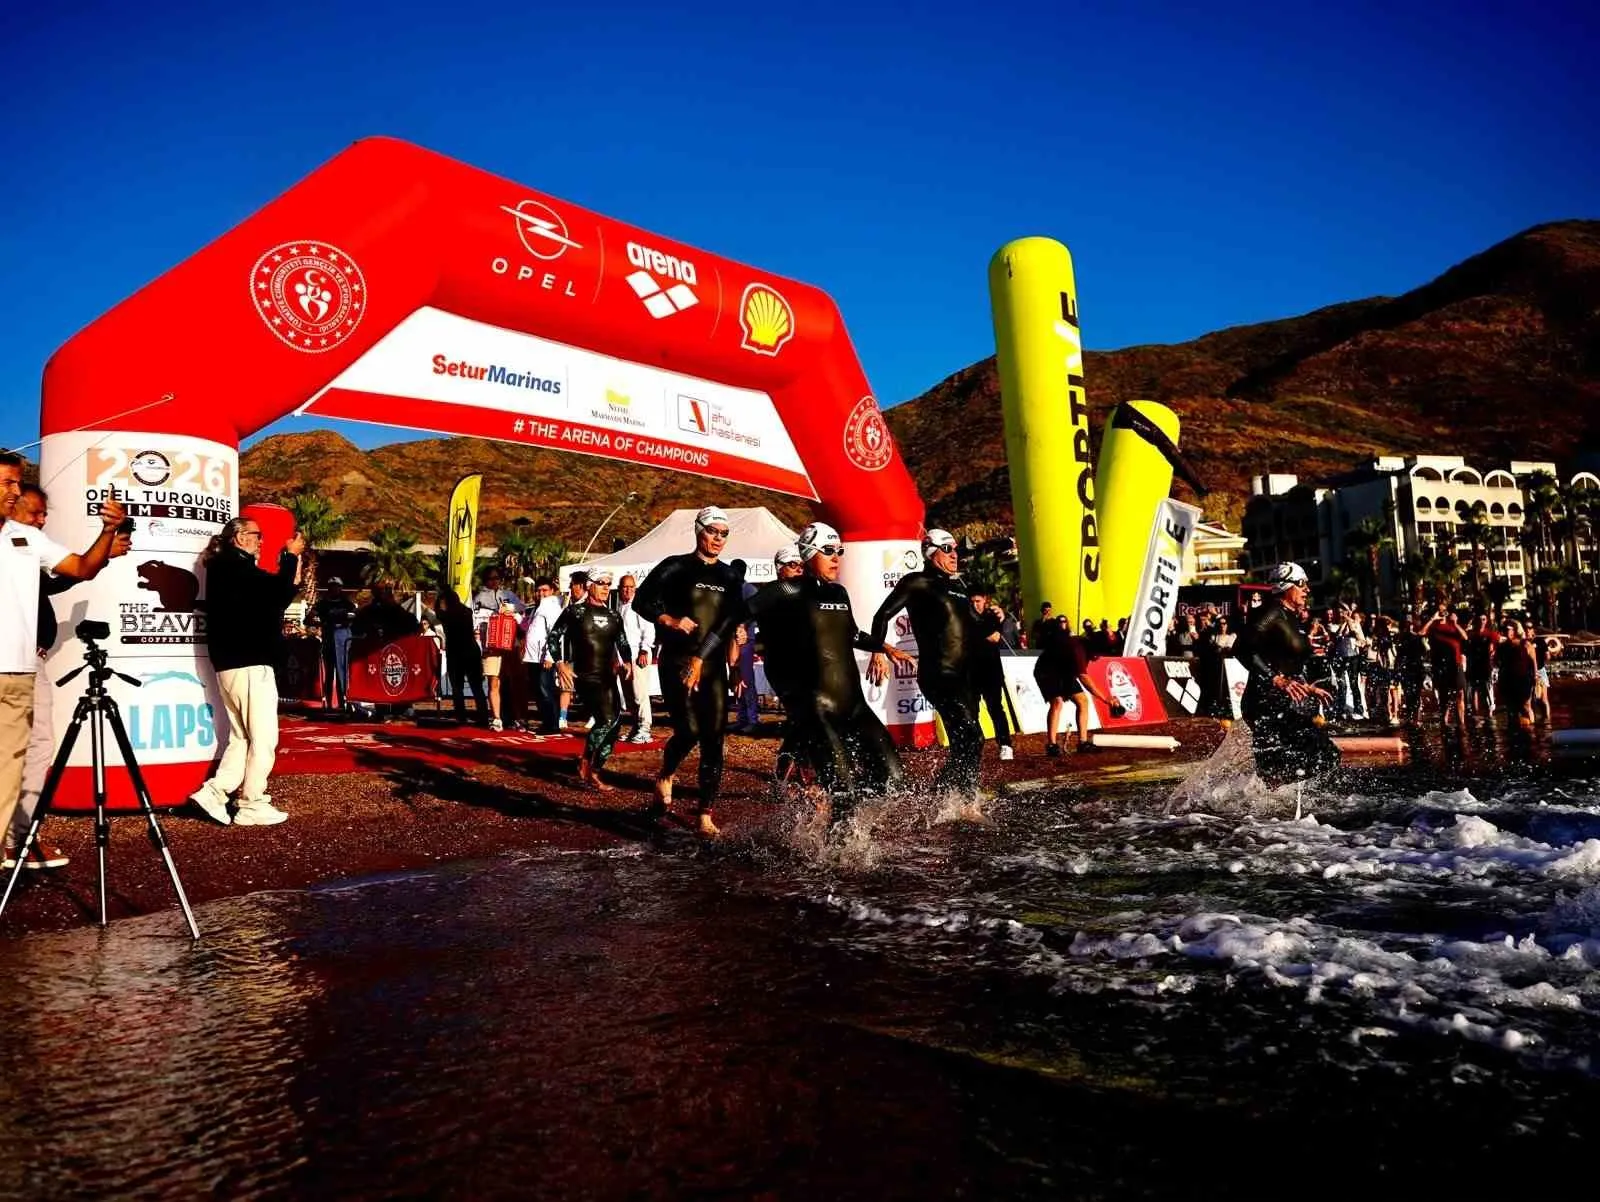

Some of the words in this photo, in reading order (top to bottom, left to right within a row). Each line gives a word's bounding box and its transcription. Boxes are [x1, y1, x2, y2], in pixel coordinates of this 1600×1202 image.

[491, 257, 577, 297] OPEL
[626, 242, 697, 284] arena
[431, 353, 561, 395] SeturMarinas
[529, 420, 557, 439] THE
[560, 427, 611, 449] ARENA
[613, 436, 633, 452] OF
[635, 440, 710, 467] CHAMPIONS
[1054, 291, 1100, 582] SPORTIVE
[86, 489, 134, 503] OPEL
[143, 490, 231, 512] TURQUOISE
[88, 502, 152, 517] SIM
[167, 506, 231, 524] SERIES
[119, 602, 150, 614] THE
[695, 583, 725, 592] orca
[129, 703, 214, 750] LAPS
